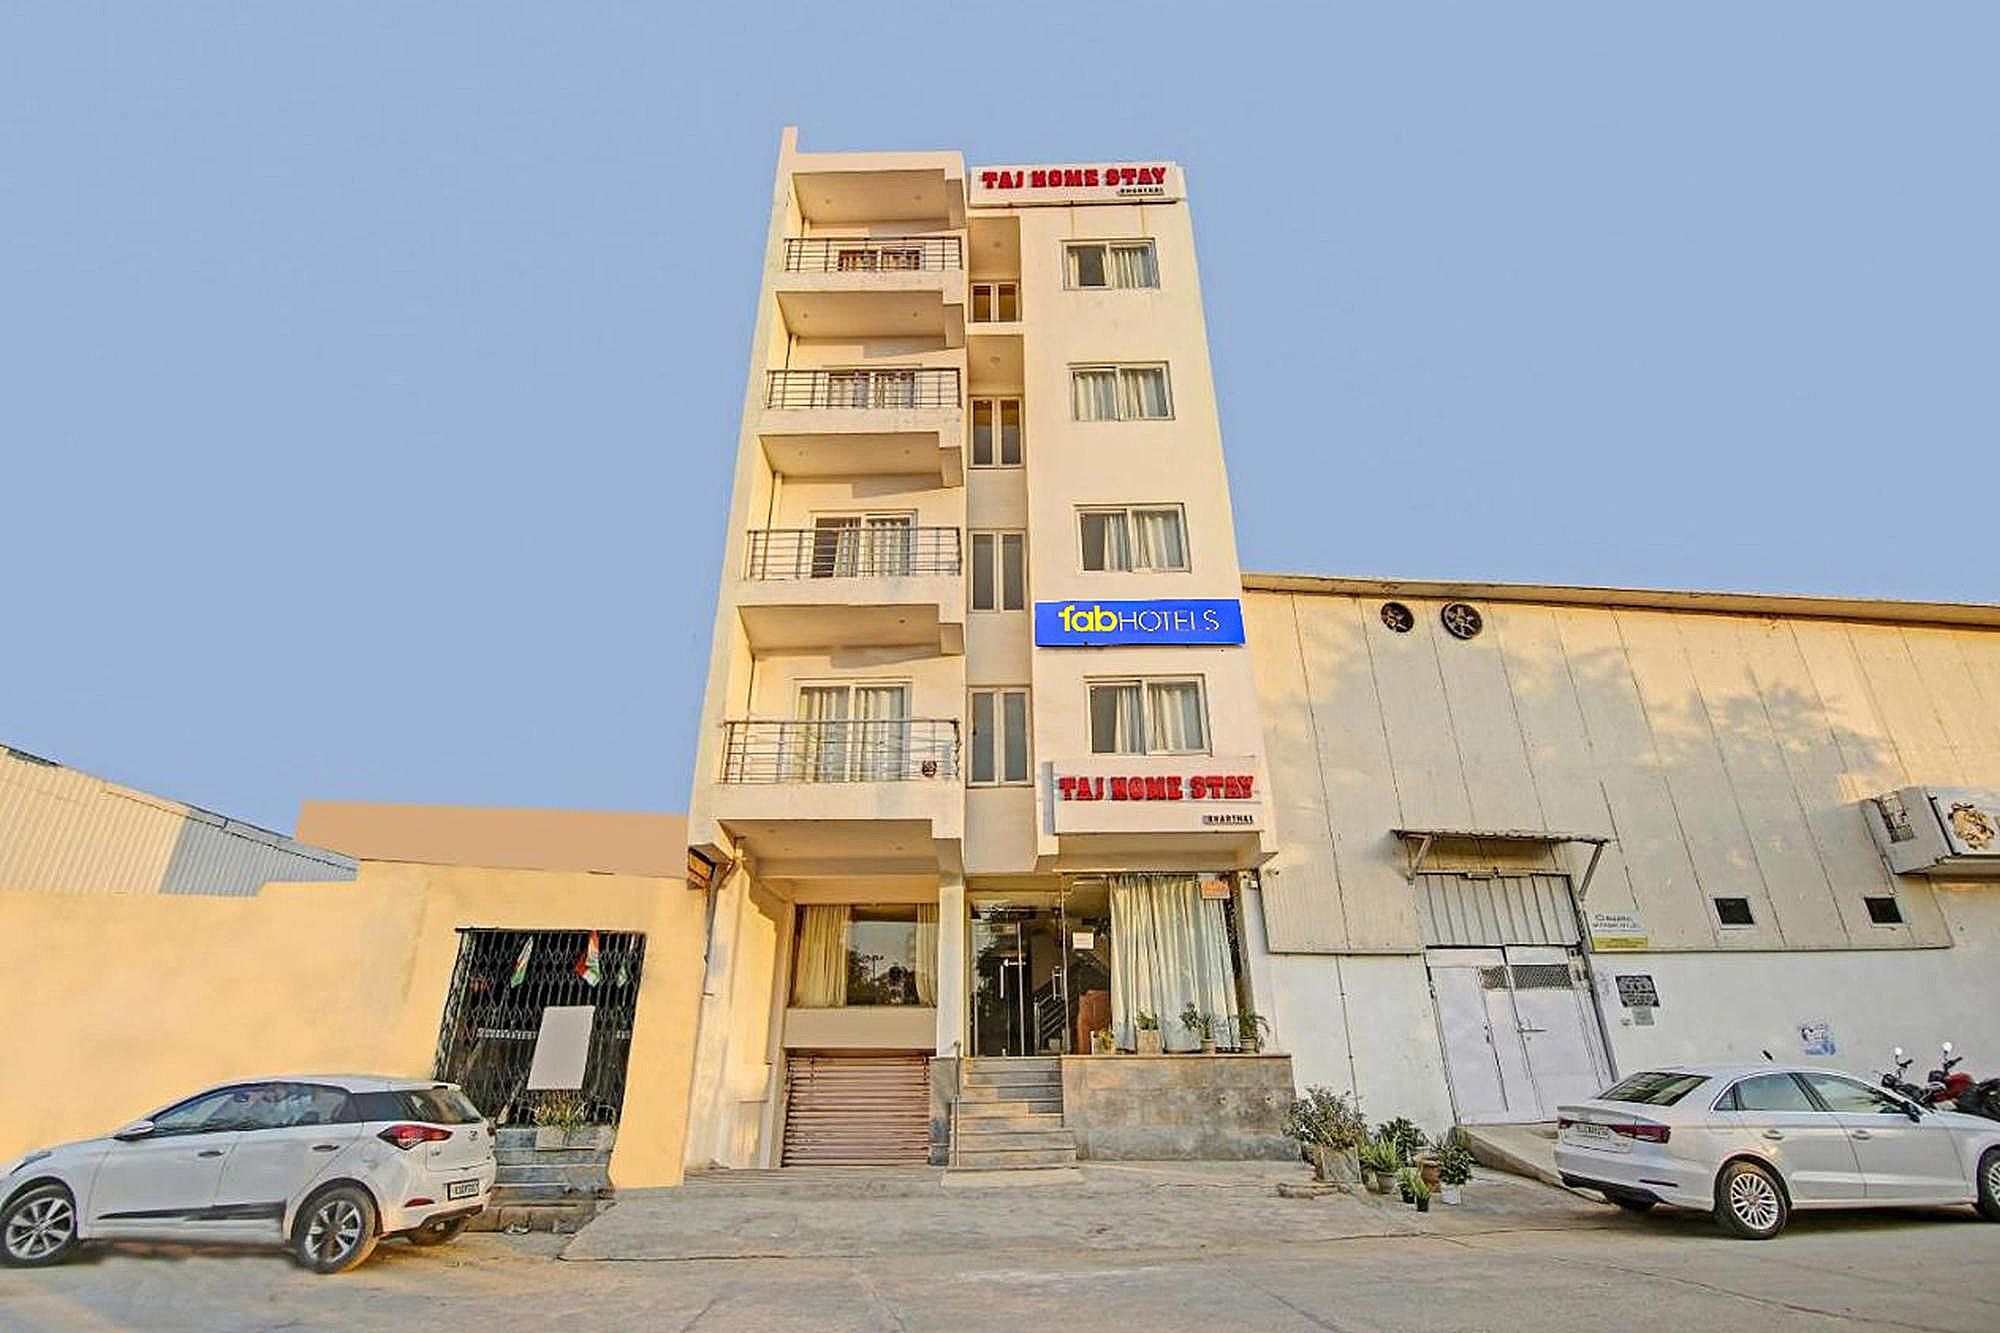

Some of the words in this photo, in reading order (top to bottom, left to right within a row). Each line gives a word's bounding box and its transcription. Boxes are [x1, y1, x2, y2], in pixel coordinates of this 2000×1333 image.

[981, 171, 1025, 189] TAJ
[1031, 169, 1099, 188] HOME
[1105, 167, 1167, 187] STAY
[1059, 776, 1105, 801] TAJ
[1110, 776, 1183, 801] HOME
[1189, 775, 1254, 799] STAY
